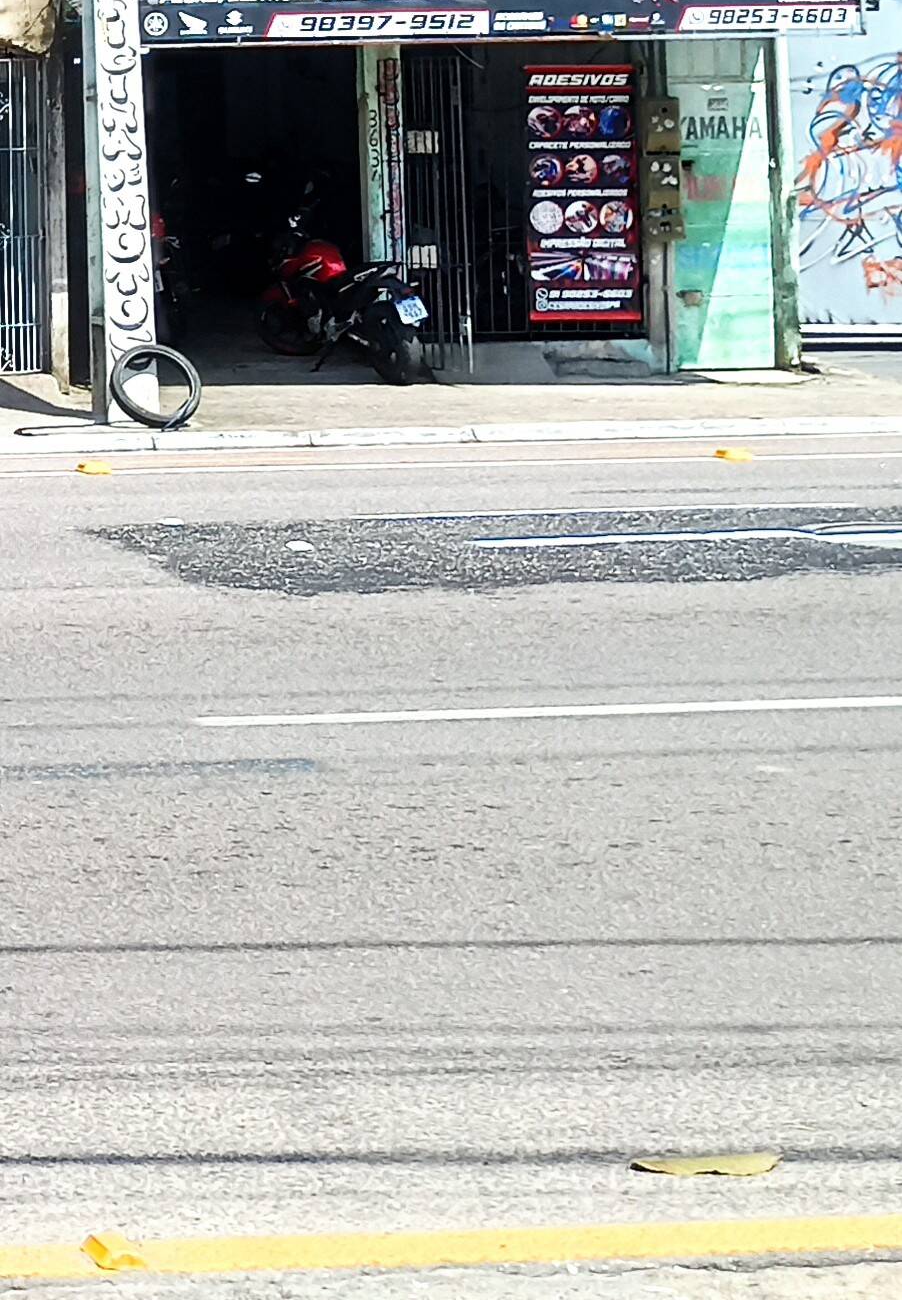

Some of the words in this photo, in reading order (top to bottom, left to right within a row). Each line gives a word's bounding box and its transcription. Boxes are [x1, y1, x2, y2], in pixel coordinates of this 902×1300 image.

[300, 14, 475, 31] 98397-9512
[708, 8, 848, 24] 98253-6603
[528, 74, 629, 86] ADESIVOS
